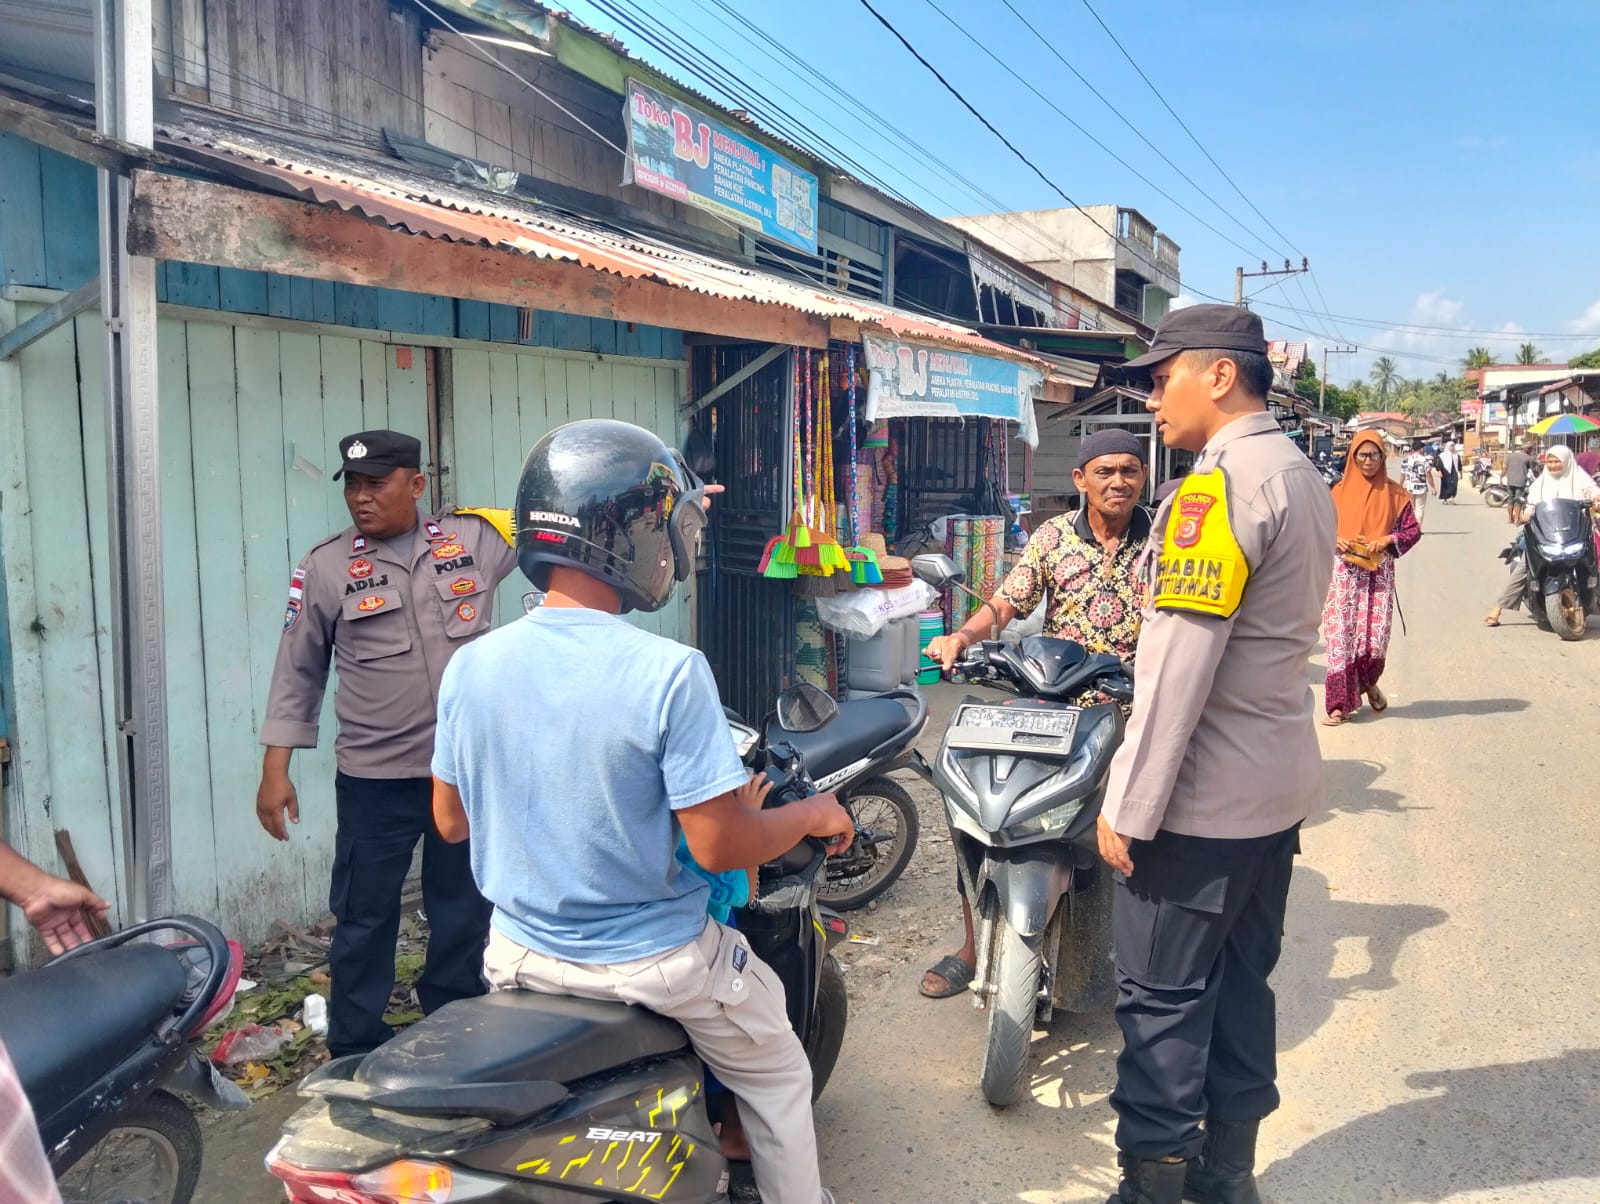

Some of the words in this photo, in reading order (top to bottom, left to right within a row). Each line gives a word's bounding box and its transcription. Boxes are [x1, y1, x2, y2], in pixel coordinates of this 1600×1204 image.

[635, 93, 670, 127] Toko
[672, 108, 710, 169] BJ
[529, 511, 581, 528] HONDA
